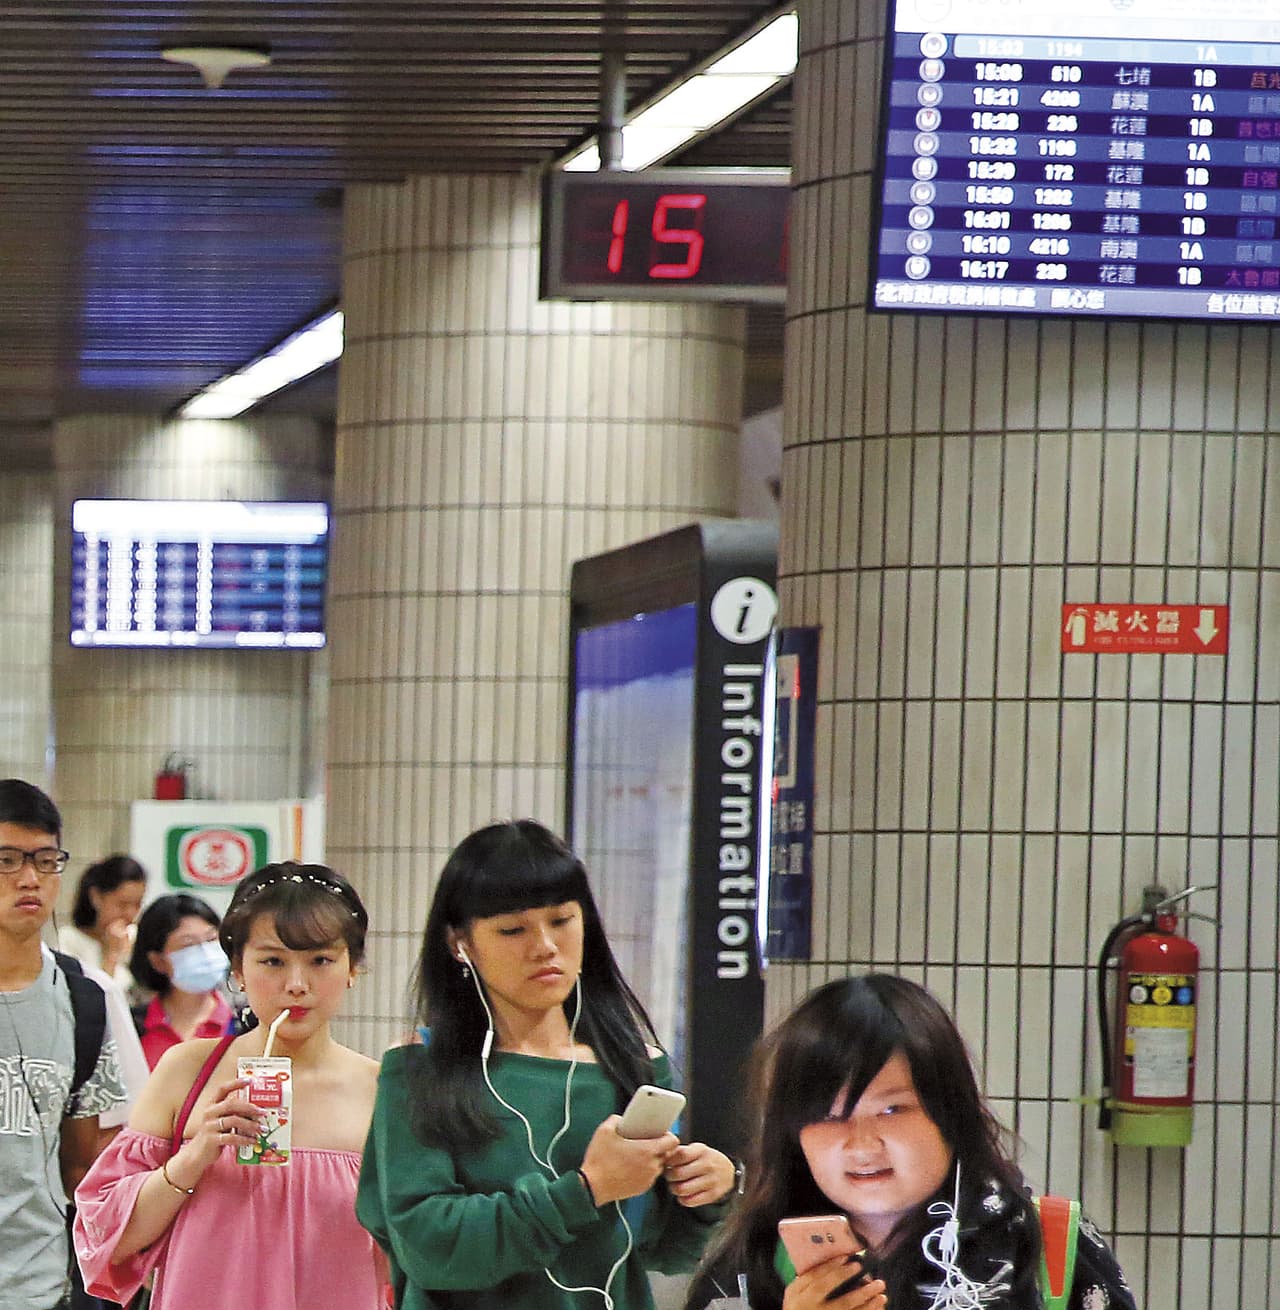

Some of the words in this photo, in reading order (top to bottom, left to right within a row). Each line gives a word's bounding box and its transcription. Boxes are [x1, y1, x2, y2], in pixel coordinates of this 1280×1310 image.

[1196, 45, 1218, 62] 1A
[1193, 69, 1217, 87] 1B
[973, 87, 1019, 106] 15:21
[1191, 94, 1215, 112] 1A
[1189, 118, 1213, 136] 1B
[1187, 143, 1211, 161] 1A
[1044, 164, 1075, 181] 172
[1185, 167, 1210, 186] 1B
[1183, 192, 1208, 210] 1B
[607, 193, 708, 279] 15
[1181, 217, 1206, 235] 1B
[961, 235, 1011, 254] 16:10
[1028, 238, 1070, 256] 4216
[1179, 242, 1204, 260] 1A
[960, 260, 1009, 279] 16:17
[1177, 267, 1202, 285] 1B
[1092, 609, 1180, 634] 滅火器
[716, 663, 763, 981] Information
